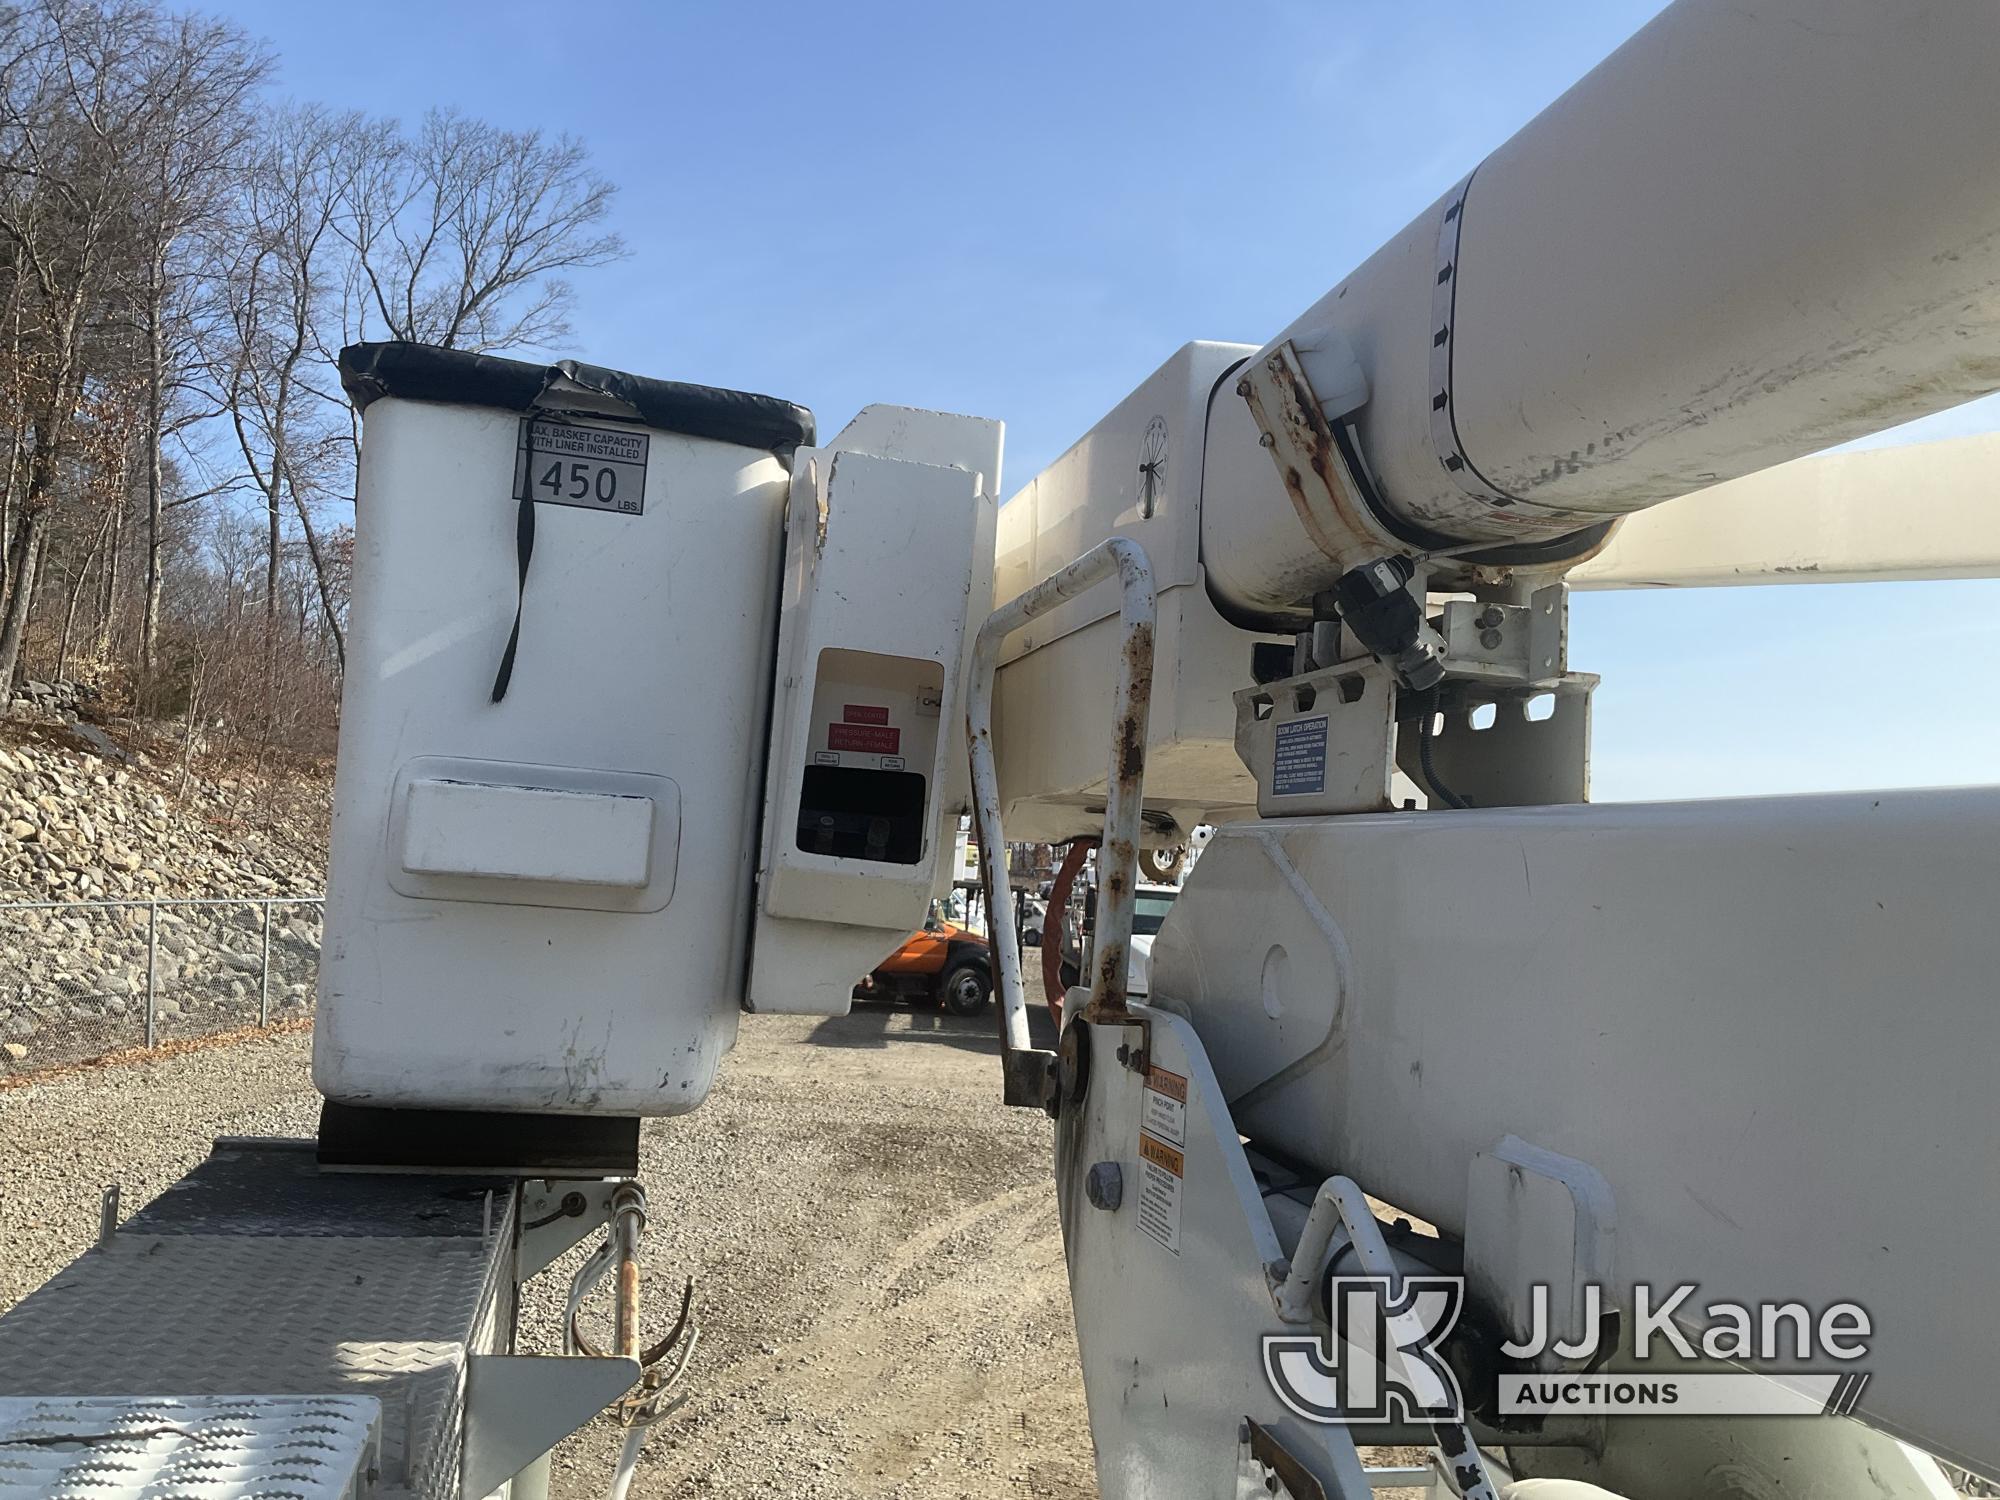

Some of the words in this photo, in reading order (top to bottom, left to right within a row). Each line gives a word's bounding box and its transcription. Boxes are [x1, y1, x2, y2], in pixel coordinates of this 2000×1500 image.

[533, 425, 549, 435] AX.
[552, 428, 591, 441] BASKET
[594, 434, 642, 448] CAPACITY
[556, 439, 584, 452] LINER
[587, 443, 639, 459] INSTALLED
[539, 461, 617, 503] 450
[618, 501, 640, 512] LBS.
[1303, 720, 1327, 732] OPERATION
[1152, 1071, 1185, 1099] WARNING
[1150, 1144, 1179, 1173] WARNING
